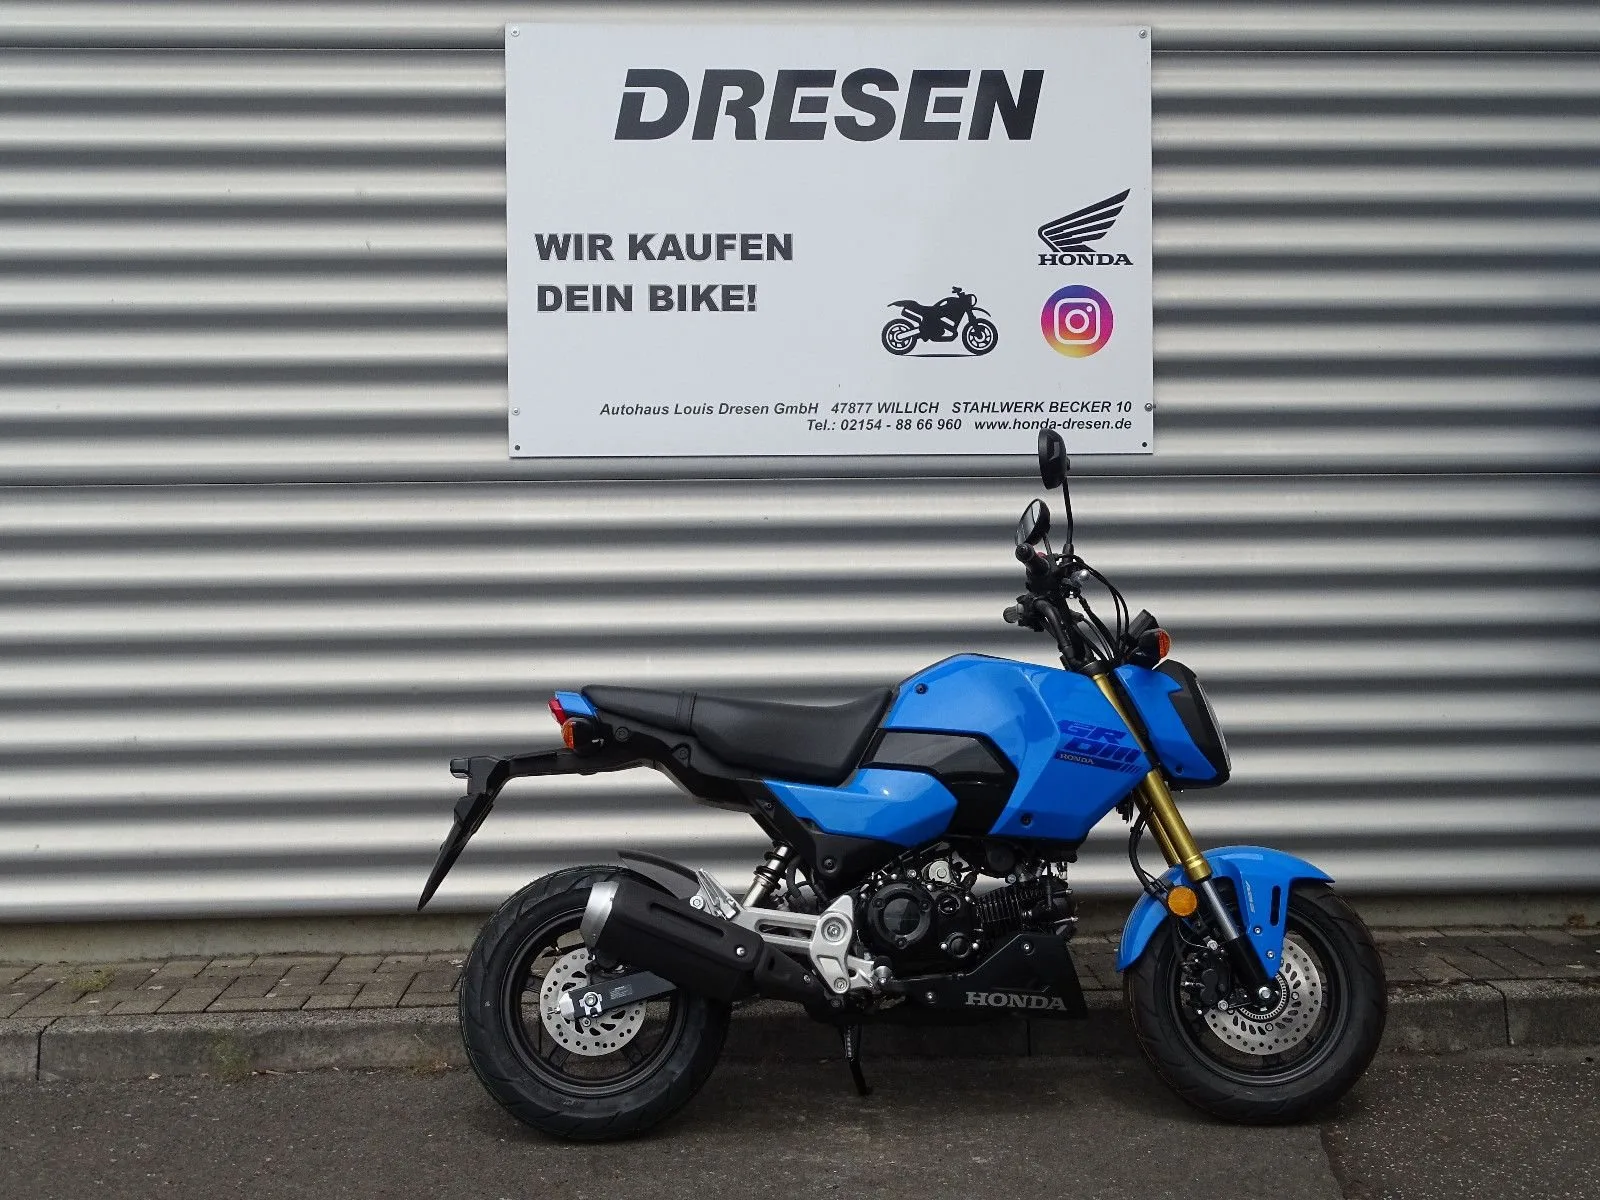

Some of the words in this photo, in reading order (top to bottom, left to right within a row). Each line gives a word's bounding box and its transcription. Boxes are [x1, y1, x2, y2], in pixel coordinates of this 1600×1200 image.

[615, 68, 1044, 141] DRESEN
[535, 233, 614, 261] WIR
[628, 233, 794, 261] KAUFEN
[1038, 253, 1134, 266] HONDA
[537, 284, 633, 312] DEIN
[648, 284, 758, 312] BIKE!
[600, 403, 669, 415] Autohaus
[674, 403, 714, 415] Louis
[718, 403, 769, 414] Dresen
[773, 403, 819, 414] GmbH
[831, 402, 873, 414] 47877
[877, 402, 939, 414] WILLICH
[951, 401, 1044, 413] STAHLWERK
[1049, 401, 1112, 413] BECKER
[1116, 401, 1132, 413] 10
[807, 419, 835, 431] Tel.:
[841, 419, 882, 431] 02154
[896, 419, 912, 430] 88
[916, 419, 933, 430] 66
[937, 419, 962, 430] 960
[974, 418, 1132, 431] www.honda-dresen.de
[965, 991, 1067, 1010] HONDA
